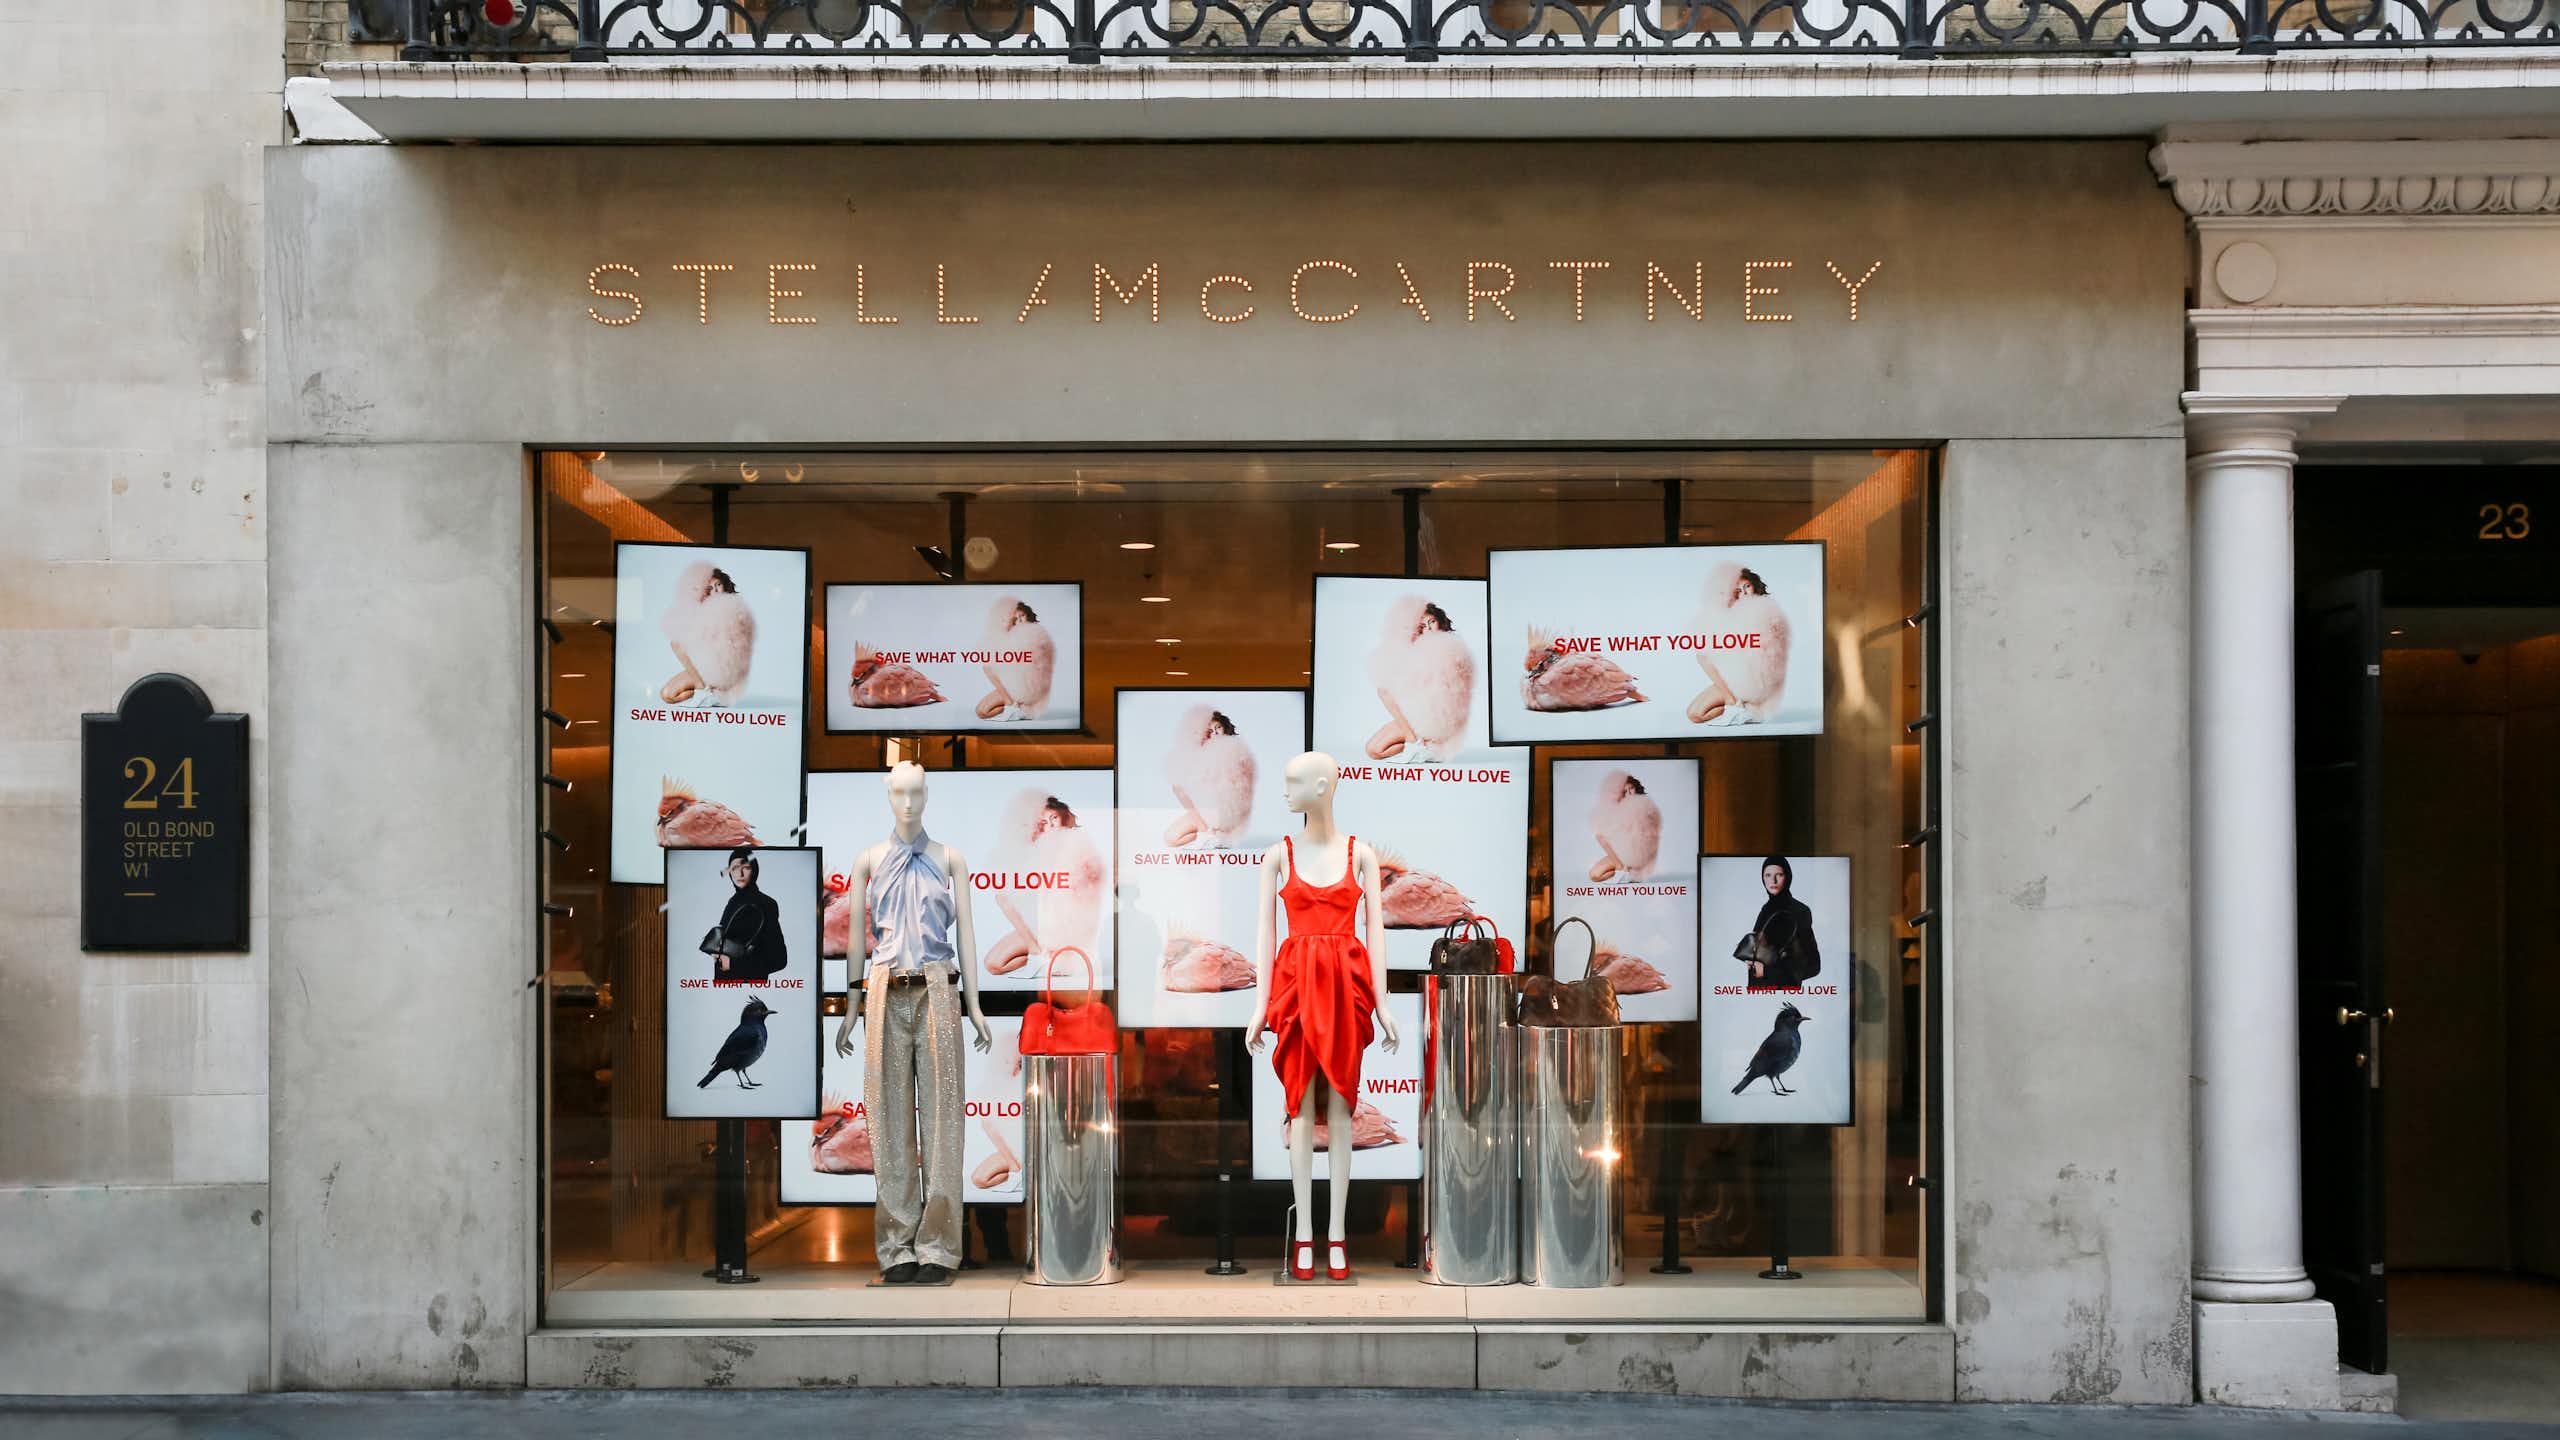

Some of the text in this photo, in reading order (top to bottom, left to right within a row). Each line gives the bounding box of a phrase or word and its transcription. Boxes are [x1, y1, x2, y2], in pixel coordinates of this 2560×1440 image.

[2479, 503, 2530, 540] 23
[1554, 633, 1761, 653] SAVE WHAT YOU LOVE
[875, 651, 1033, 664] SAVE WHAT YOU LOVE
[631, 709, 786, 726] SAVE WHAT YOU LOVE
[123, 756, 201, 809] 24
[1377, 768, 1424, 781] WHAT
[1429, 769, 1463, 782] YOU
[1468, 770, 1511, 783] LOVE
[123, 821, 215, 838] OLD BOND
[123, 841, 195, 858] STREET
[1134, 853, 1170, 865] SAVE
[1174, 853, 1215, 865] WHAT
[1218, 853, 1248, 865] YOU
[123, 861, 149, 879] W1
[1014, 872, 1070, 889] LOVE
[1566, 886, 1687, 897] SAVE WHAT YOU LOVE
[680, 979, 709, 989] SAVE
[712, 979, 744, 989] WHAT
[774, 979, 804, 989] LOVE
[1714, 985, 1743, 995] SAVE
[1746, 985, 1778, 995] WHAT
[1808, 985, 1838, 995] LOVE
[1366, 1079, 1418, 1093] WHAT
[965, 1102, 991, 1117] OU
